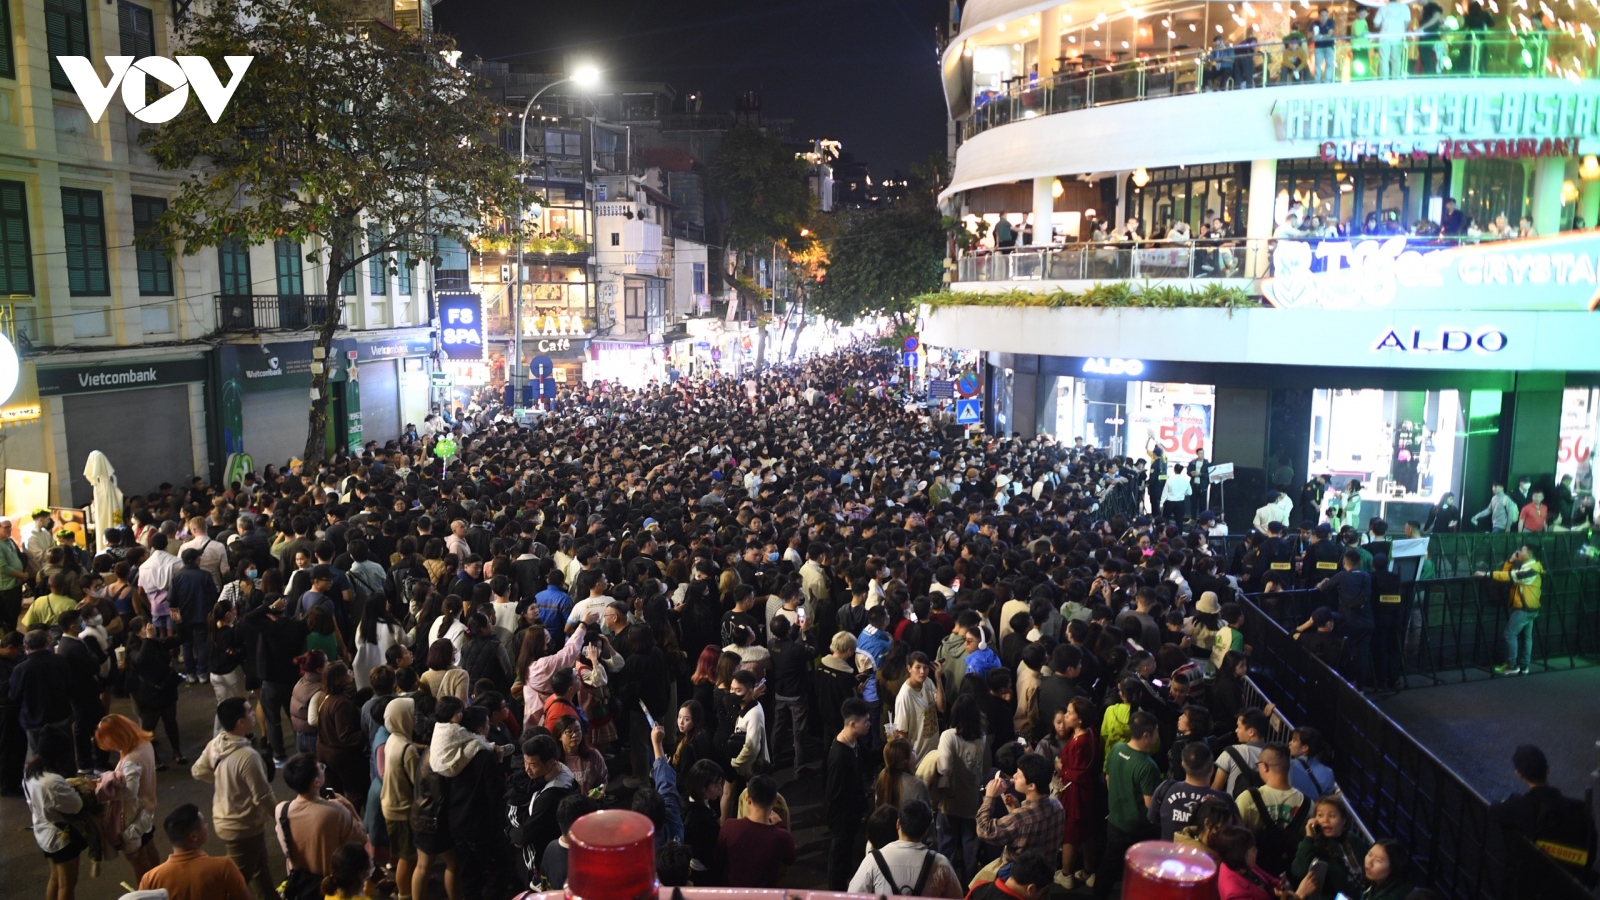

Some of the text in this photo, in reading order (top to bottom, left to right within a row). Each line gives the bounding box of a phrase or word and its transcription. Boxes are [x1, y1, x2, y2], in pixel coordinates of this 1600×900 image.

[1319, 139, 1403, 164] COFFEE
[1437, 137, 1583, 160] RESTAURANT
[1459, 252, 1600, 285] CRYSTA
[447, 308, 474, 324] FS
[522, 315, 586, 337] KAFA
[443, 328, 481, 344] SPA
[538, 338, 571, 352] Café
[1376, 329, 1508, 352] ALDO
[371, 345, 409, 356] Vietcombank
[246, 368, 283, 378] Vietcombank
[1082, 357, 1144, 376] ALDO
[78, 367, 157, 388] Vietcombank
[1159, 425, 1204, 455] 50
[1167, 792, 1187, 804] ANTA
[1541, 843, 1584, 862] SECURITY
